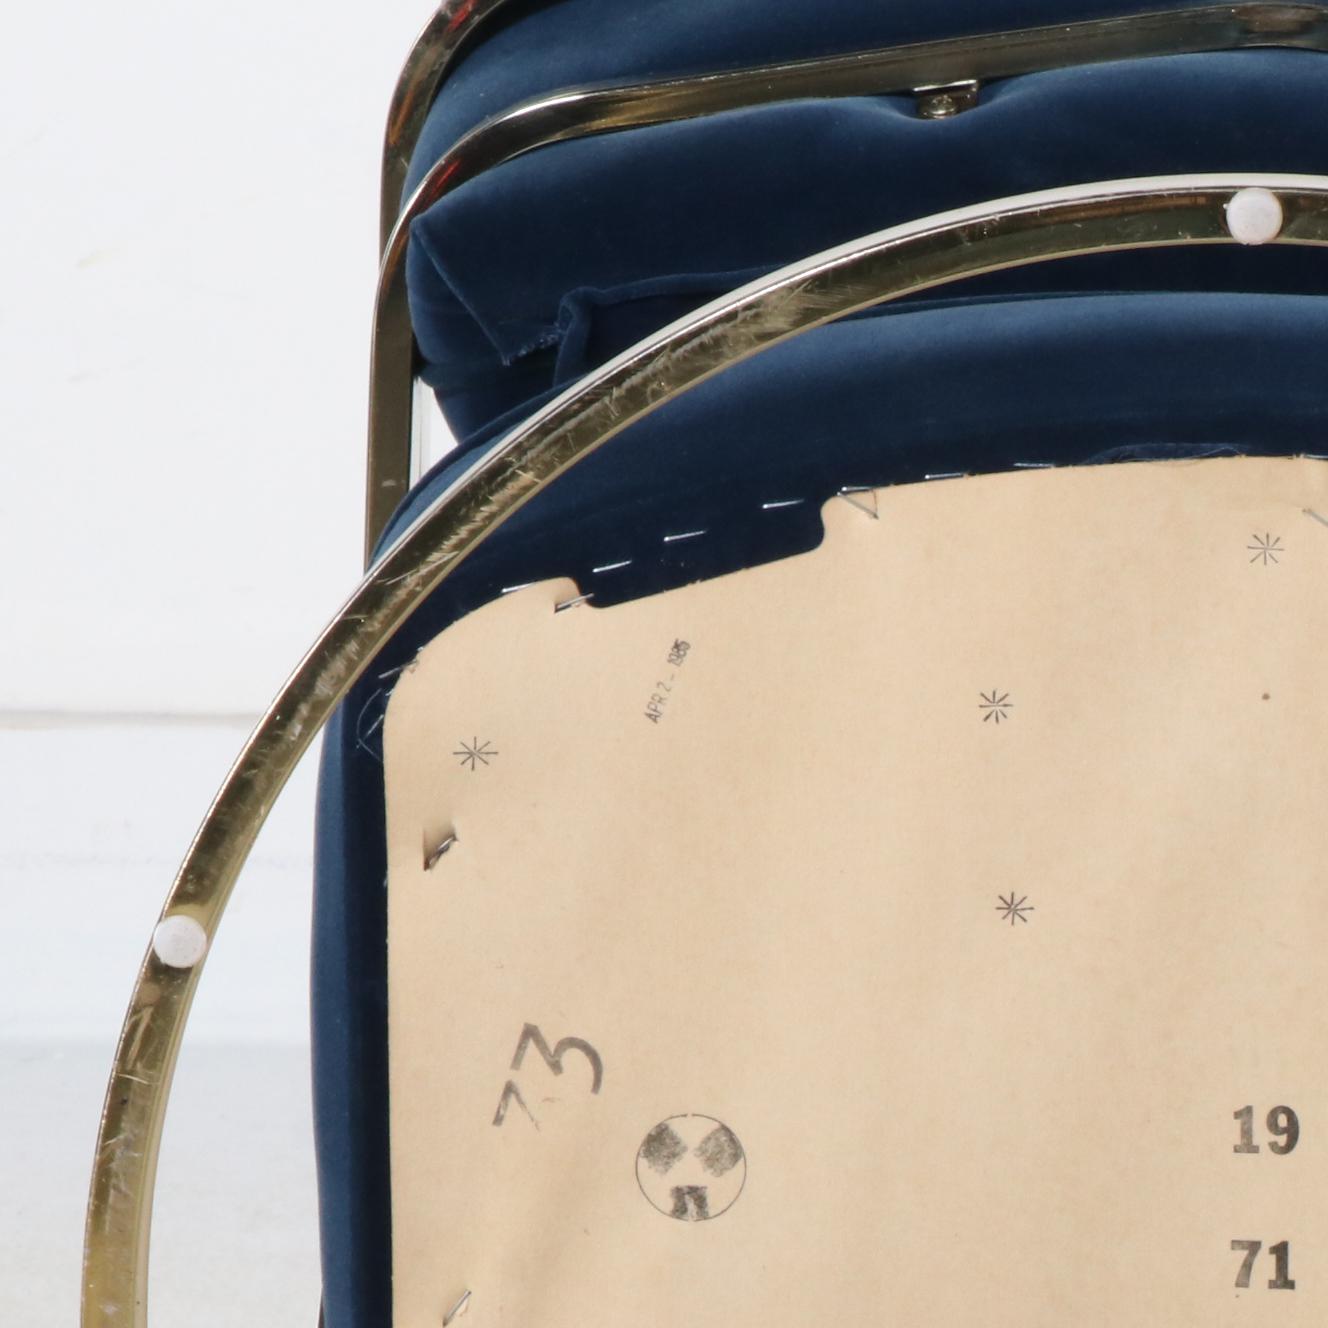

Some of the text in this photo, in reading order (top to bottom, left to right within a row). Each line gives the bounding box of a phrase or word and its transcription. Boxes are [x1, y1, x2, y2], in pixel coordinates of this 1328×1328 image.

[644, 693, 667, 724] APR
[1233, 1105, 1300, 1155] 19
[1231, 1240, 1295, 1290] 71
